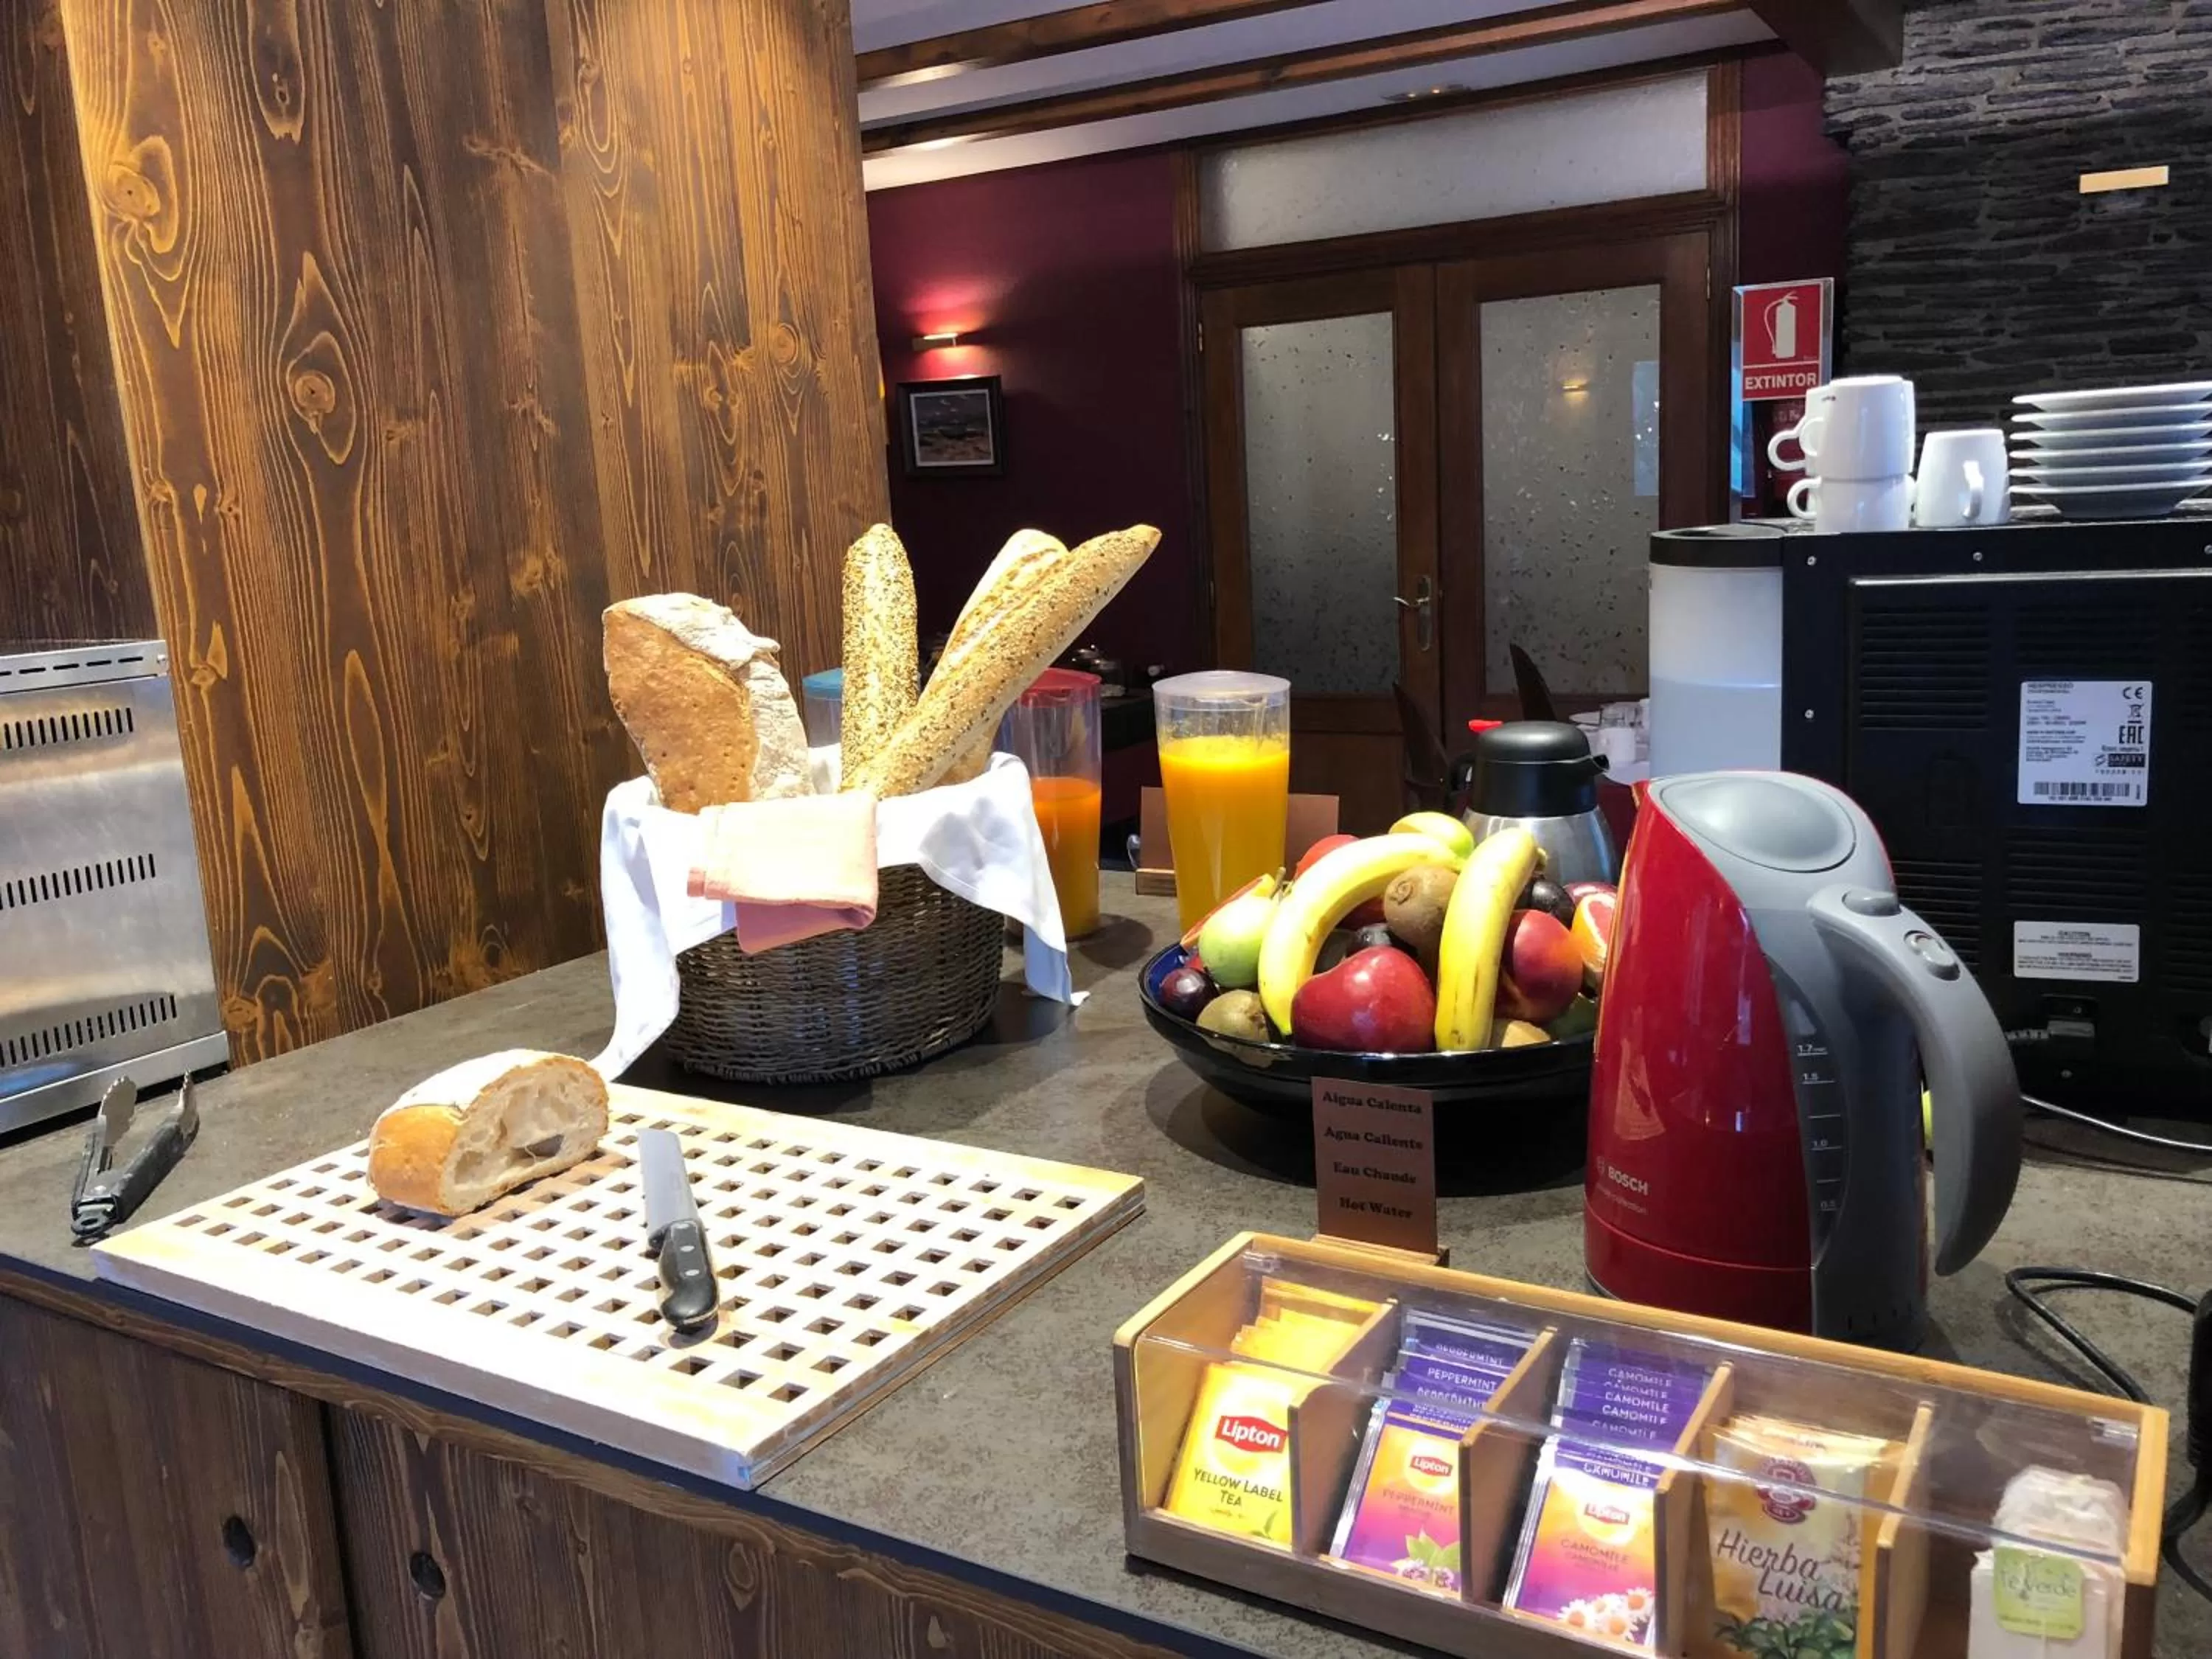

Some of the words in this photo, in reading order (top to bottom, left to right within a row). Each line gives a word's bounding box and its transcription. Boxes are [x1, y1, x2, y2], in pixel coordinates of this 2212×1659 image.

[1745, 372, 1817, 390] EXTINTOR
[1322, 1091, 1363, 1107] Aigua
[1324, 1126, 1360, 1142] Agua
[1363, 1132, 1424, 1150] Caliente
[1333, 1161, 1360, 1176] Eau
[1363, 1166, 1416, 1184] Chaude
[1608, 1166, 1649, 1196] BOSCH
[1338, 1196, 1366, 1211] Hot
[1368, 1202, 1413, 1220] Water
[1427, 1367, 1498, 1392] PEPPERMINT
[1604, 1391, 1670, 1413] CAMOMILE
[1221, 1419, 1280, 1449] Lipton
[1414, 1457, 1450, 1475] Lipton
[1194, 1467, 1241, 1490] YELLOW
[1243, 1480, 1283, 1503] LABEL
[1220, 1489, 1242, 1506] TEA
[1717, 1527, 1832, 1582] Hierba
[1757, 1567, 1845, 1612] Luisa
